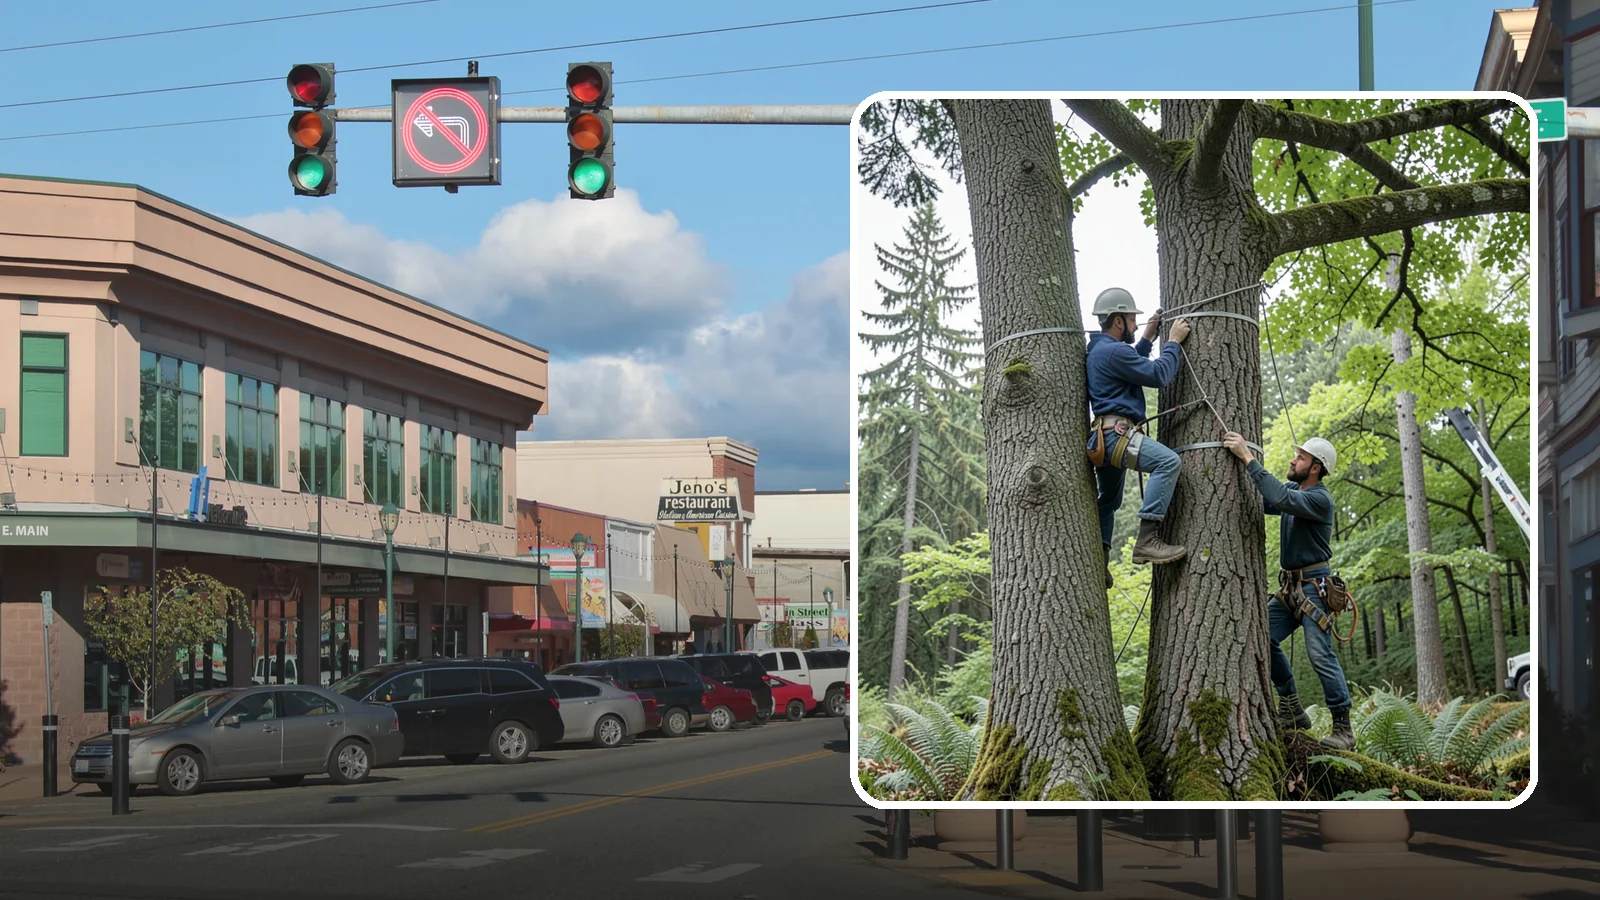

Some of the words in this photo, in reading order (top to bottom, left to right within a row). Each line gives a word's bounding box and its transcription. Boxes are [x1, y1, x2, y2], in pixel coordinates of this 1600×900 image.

[669, 480, 728, 494] Jeno's
[665, 496, 731, 509] restaurant
[658, 509, 681, 519] Italian
[686, 509, 714, 519] American
[715, 509, 737, 519] Cuisine
[2, 525, 13, 536] E.
[15, 525, 49, 536] MAIN
[797, 607, 829, 617] Street
[791, 619, 824, 627] lass
